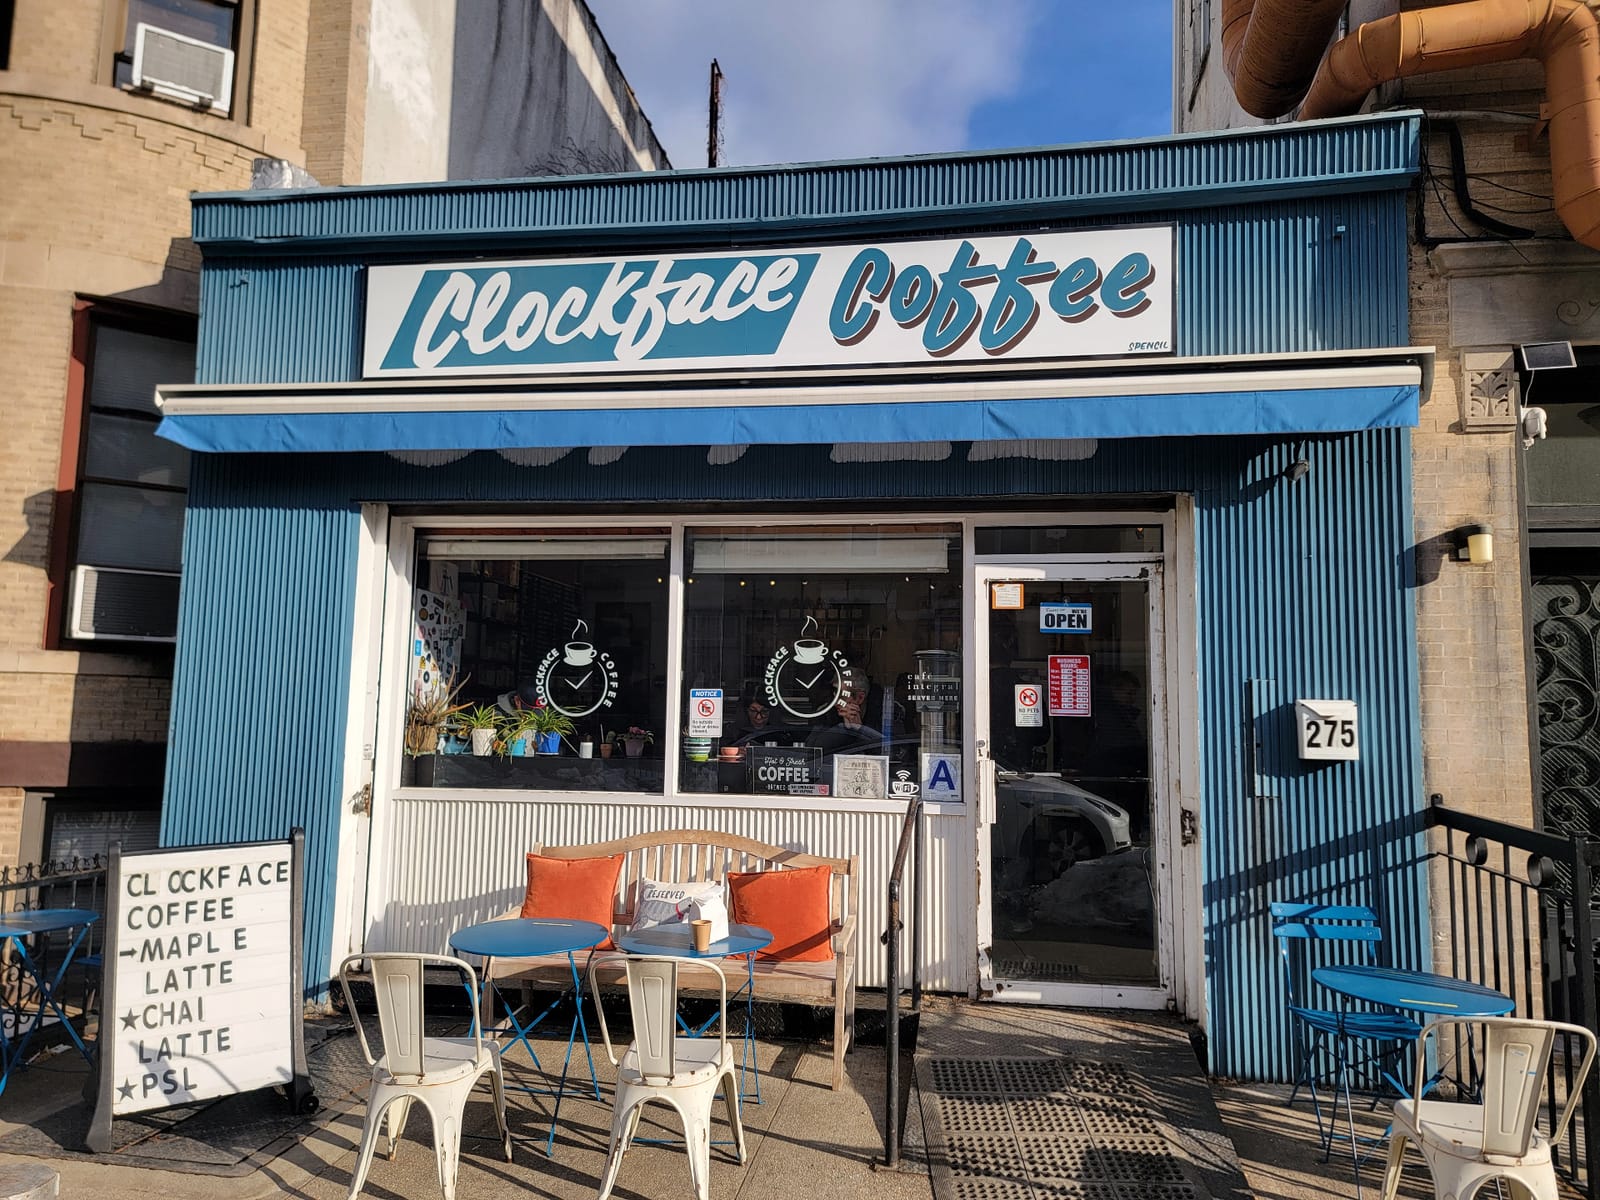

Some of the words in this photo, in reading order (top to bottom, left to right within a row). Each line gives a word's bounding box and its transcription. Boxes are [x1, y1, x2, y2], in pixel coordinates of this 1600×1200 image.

[413, 258, 799, 369] Clockface
[829, 237, 1155, 356] Coffee
[1044, 613, 1087, 628] OPEN
[535, 648, 559, 706] CLOCKFACE
[600, 653, 619, 708] COFFEE
[764, 646, 789, 707] CLOCKFACE
[832, 650, 853, 708] COFFEE
[907, 681, 959, 692] integral
[1306, 720, 1355, 748] 275
[758, 766, 810, 782] COFFEE
[928, 760, 956, 790] A
[127, 861, 289, 897] CLOCKFACE
[647, 889, 685, 899] RESERVED
[127, 897, 234, 930] COFFEE
[140, 928, 248, 962] MAPLE
[145, 960, 233, 995] LATTE
[142, 996, 205, 1029] CHAI
[138, 1027, 231, 1064] LATTE
[142, 1067, 197, 1099] PSL
